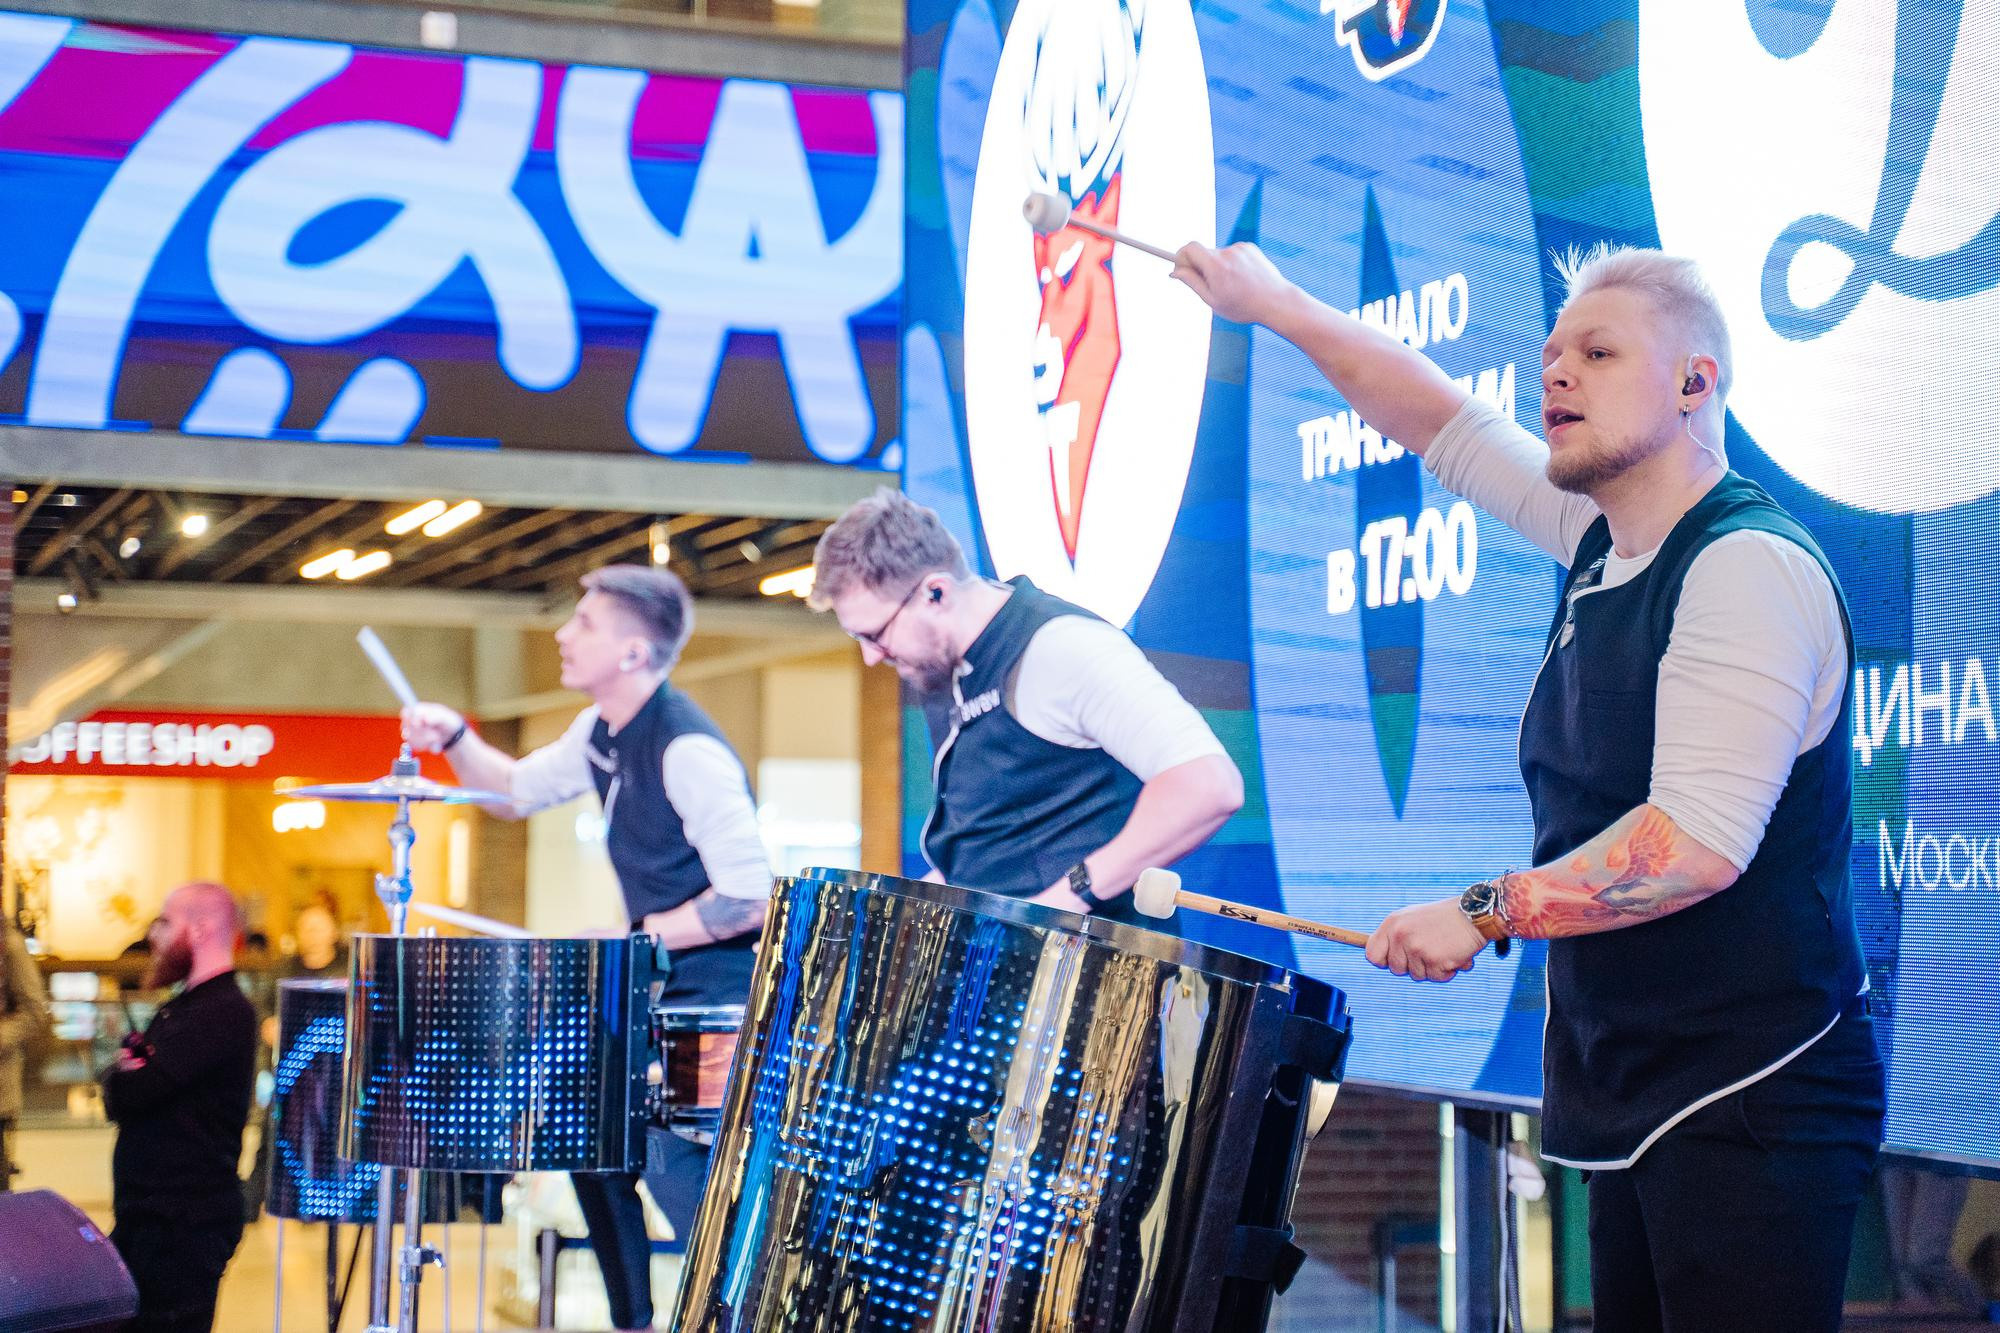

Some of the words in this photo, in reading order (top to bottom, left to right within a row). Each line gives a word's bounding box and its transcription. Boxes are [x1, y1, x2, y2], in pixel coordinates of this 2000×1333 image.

[1327, 548, 1356, 615] В
[1360, 501, 1478, 610] 17:00
[1879, 818, 2000, 892] Моск
